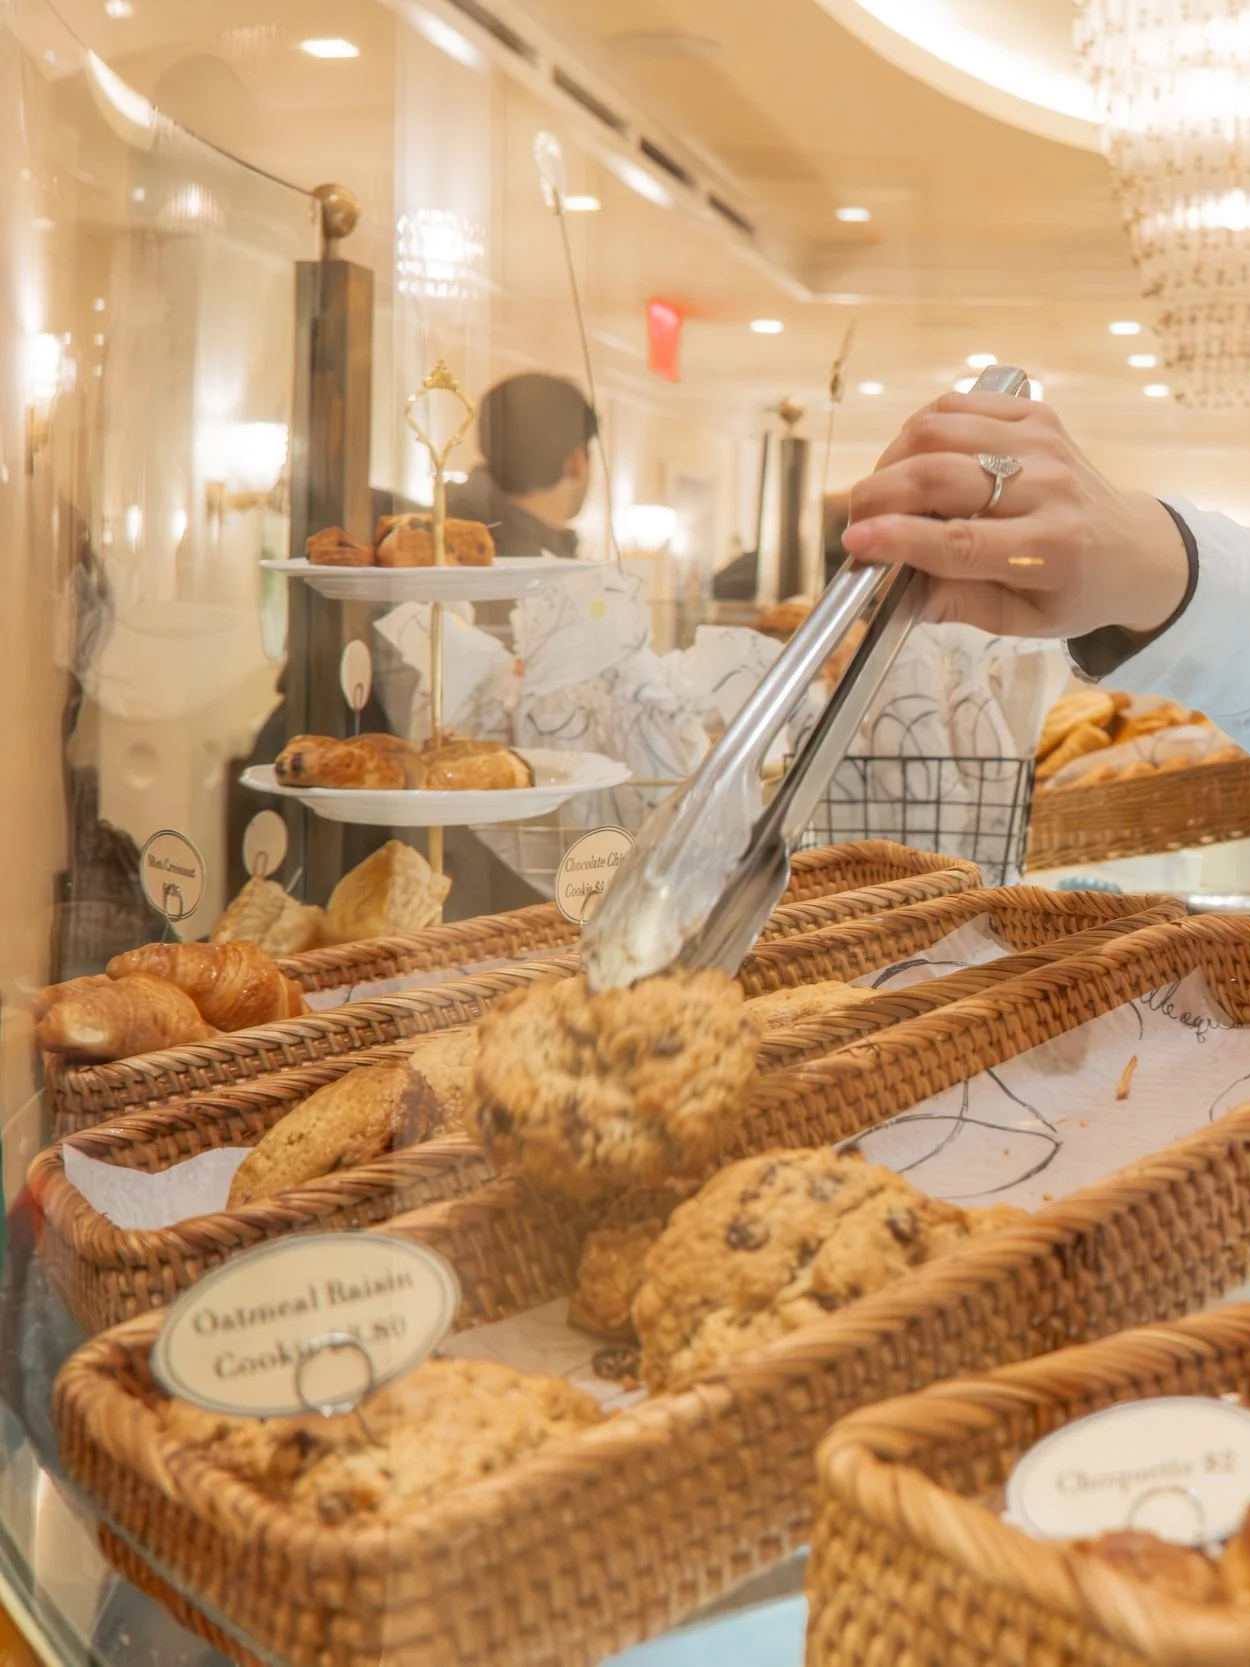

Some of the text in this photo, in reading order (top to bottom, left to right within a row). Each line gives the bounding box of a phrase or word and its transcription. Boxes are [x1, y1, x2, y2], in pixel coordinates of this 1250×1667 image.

[565, 850, 629, 872] Chocolate Chi
[565, 881, 593, 898] Cookie
[192, 1268, 413, 1335] Oatmeal Raisin
